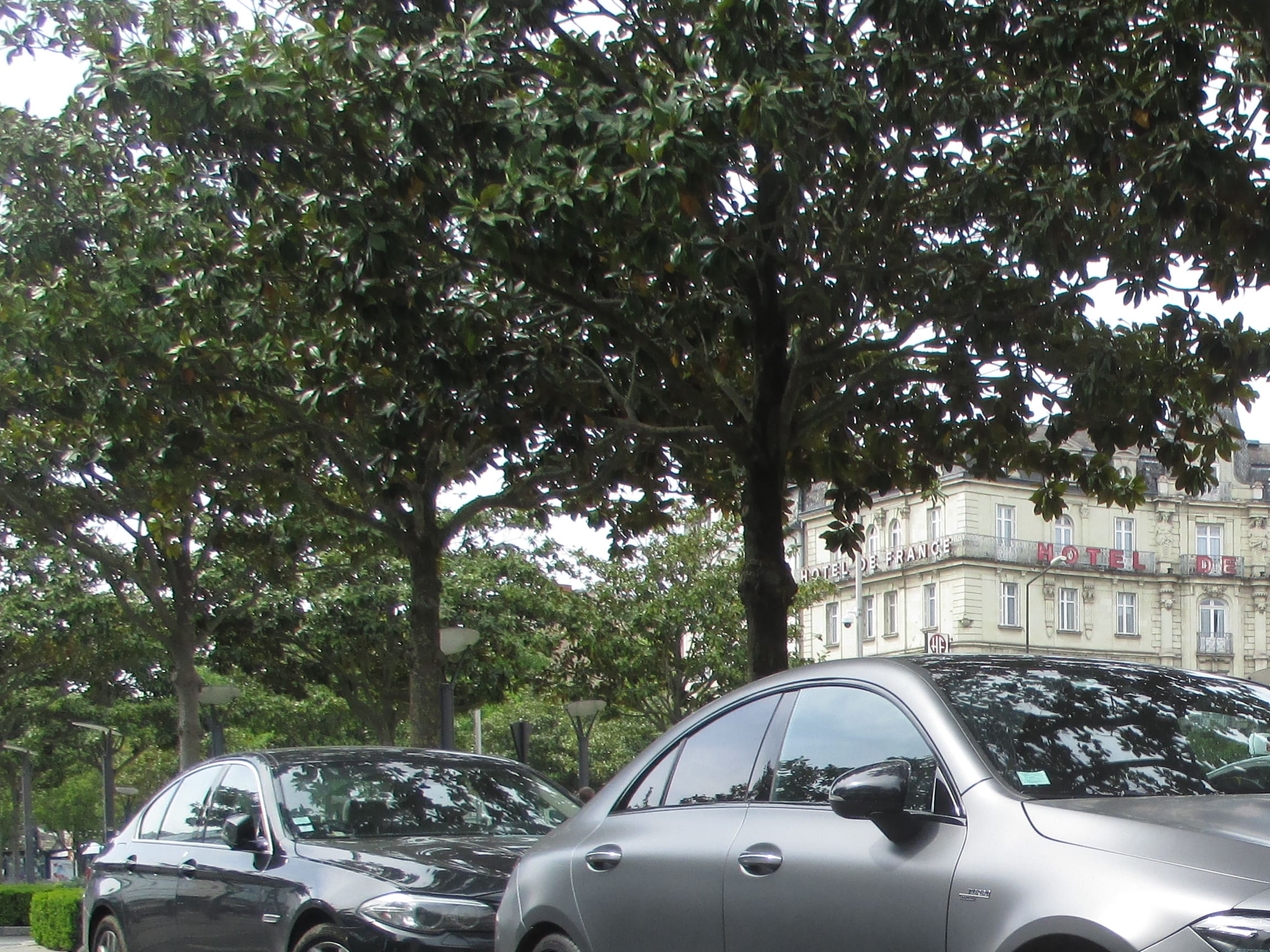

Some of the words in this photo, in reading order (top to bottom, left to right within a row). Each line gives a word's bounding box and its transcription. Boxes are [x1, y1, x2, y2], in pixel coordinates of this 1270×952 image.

[801, 561, 849, 582] HOTEL
[886, 538, 952, 566] FRANCE
[1037, 542, 1146, 570] HOTEL
[1196, 555, 1237, 574] DE
